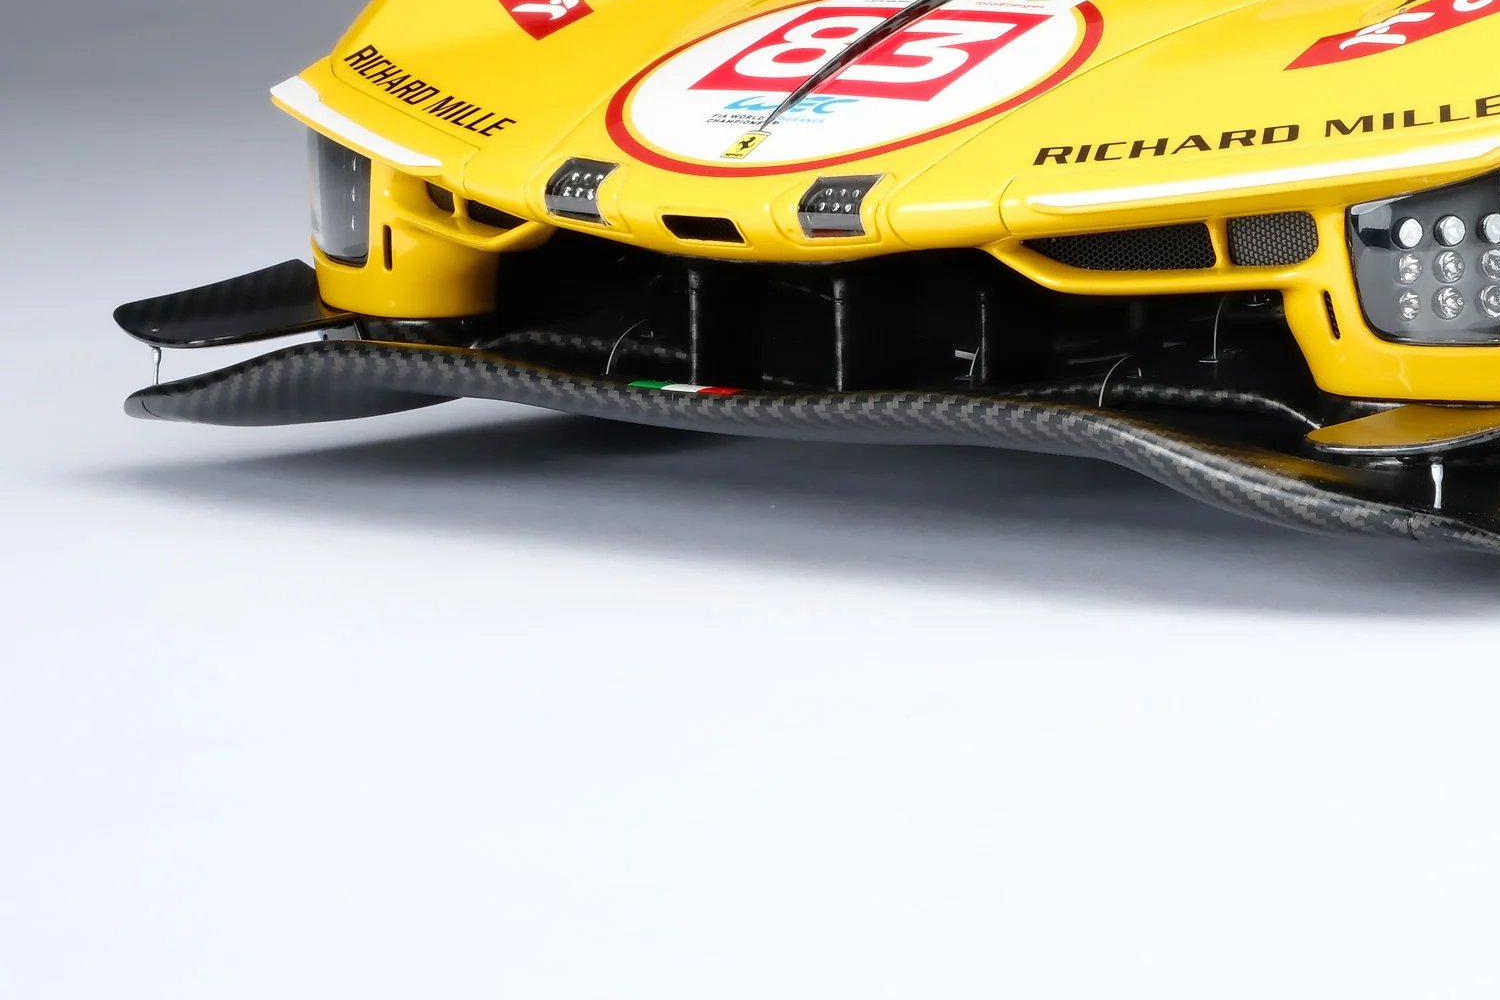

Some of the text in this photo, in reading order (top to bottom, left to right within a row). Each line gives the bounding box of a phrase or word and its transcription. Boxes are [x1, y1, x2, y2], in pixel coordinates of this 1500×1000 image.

[734, 14, 1019, 83] 83
[344, 43, 517, 138] RICHARD MILLE
[1032, 124, 1300, 166] RICHARD
